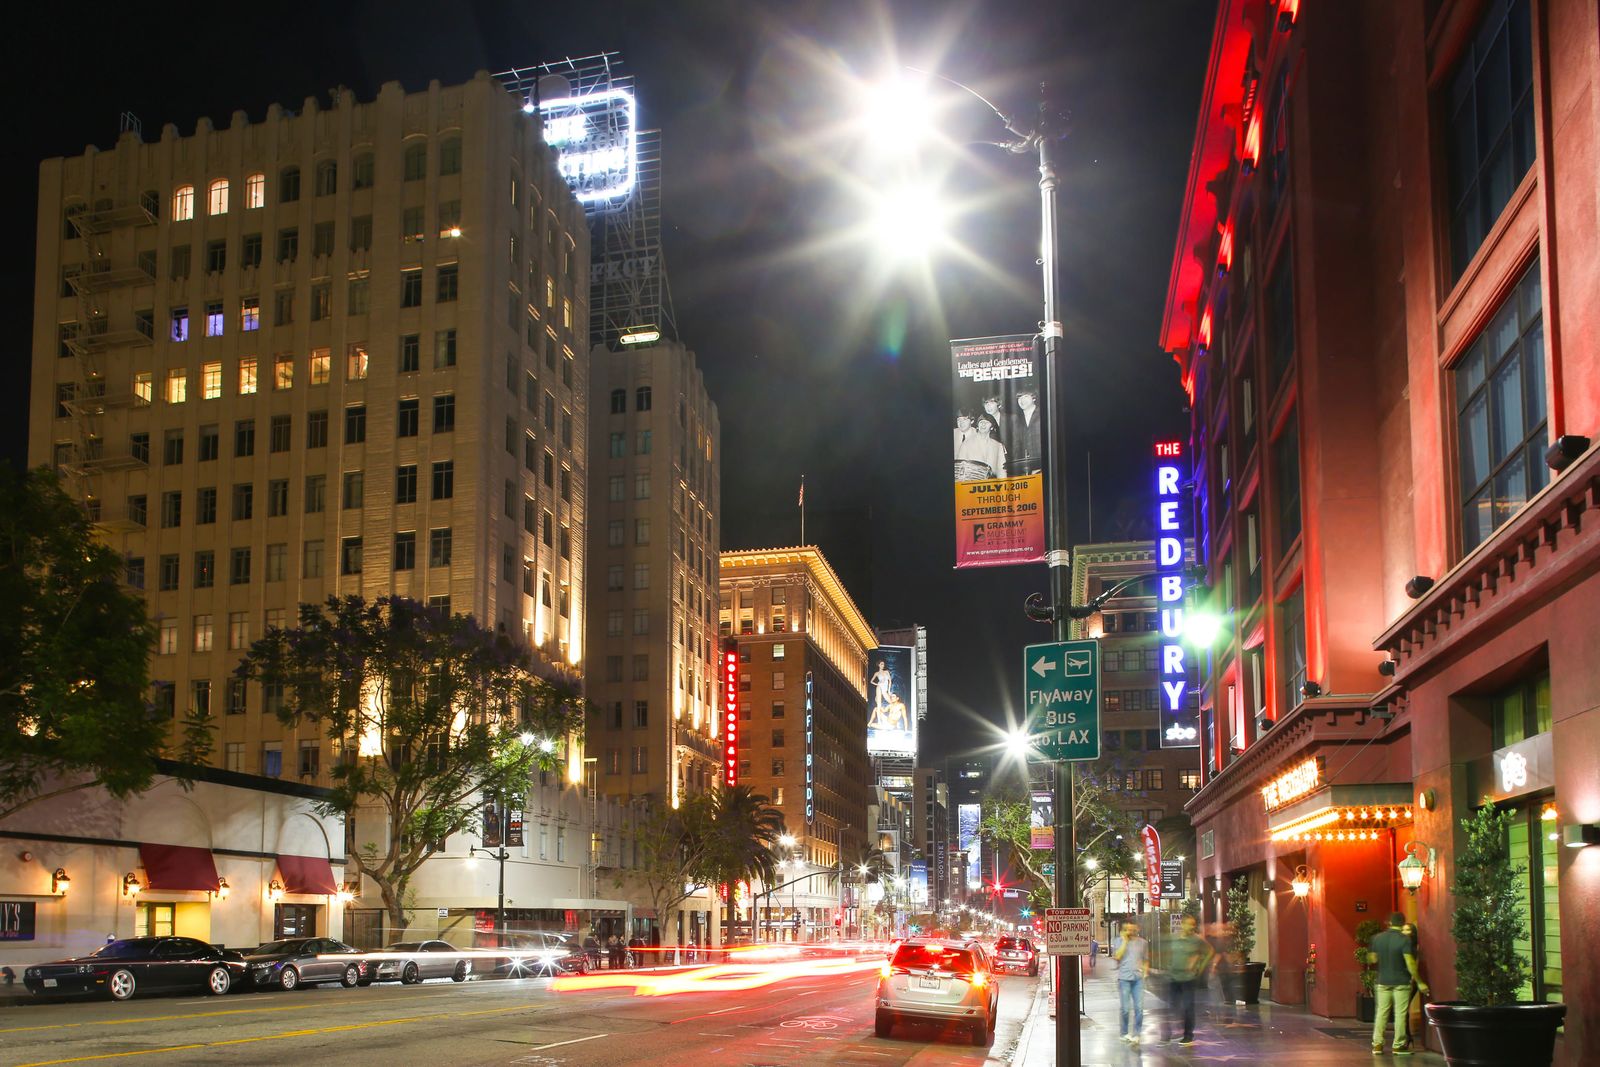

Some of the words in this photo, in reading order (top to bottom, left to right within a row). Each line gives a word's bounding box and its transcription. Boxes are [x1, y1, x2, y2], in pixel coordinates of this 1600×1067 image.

[958, 361, 979, 369] Ladies
[980, 359, 993, 368] and
[973, 364, 1033, 382] BEATLES!
[1156, 442, 1180, 456] THE
[969, 484, 1003, 493] JULY
[977, 494, 1021, 504] THROUGH
[961, 506, 1006, 516] SEPTEMBER
[1007, 505, 1015, 514] 5,
[1017, 503, 1037, 512] 2016
[987, 520, 1024, 529] GRAMMY
[967, 546, 1033, 555] www.grammymuseum.org
[1158, 466, 1186, 710] REDBURY
[727, 654, 736, 741] HOLLYWOOD
[1030, 689, 1093, 707] FlyAway
[1047, 711, 1076, 725] Bus
[1058, 729, 1089, 744] LAX
[728, 746, 735, 754] &
[1049, 922, 1060, 932] NO
[1063, 923, 1088, 931] PARKING
